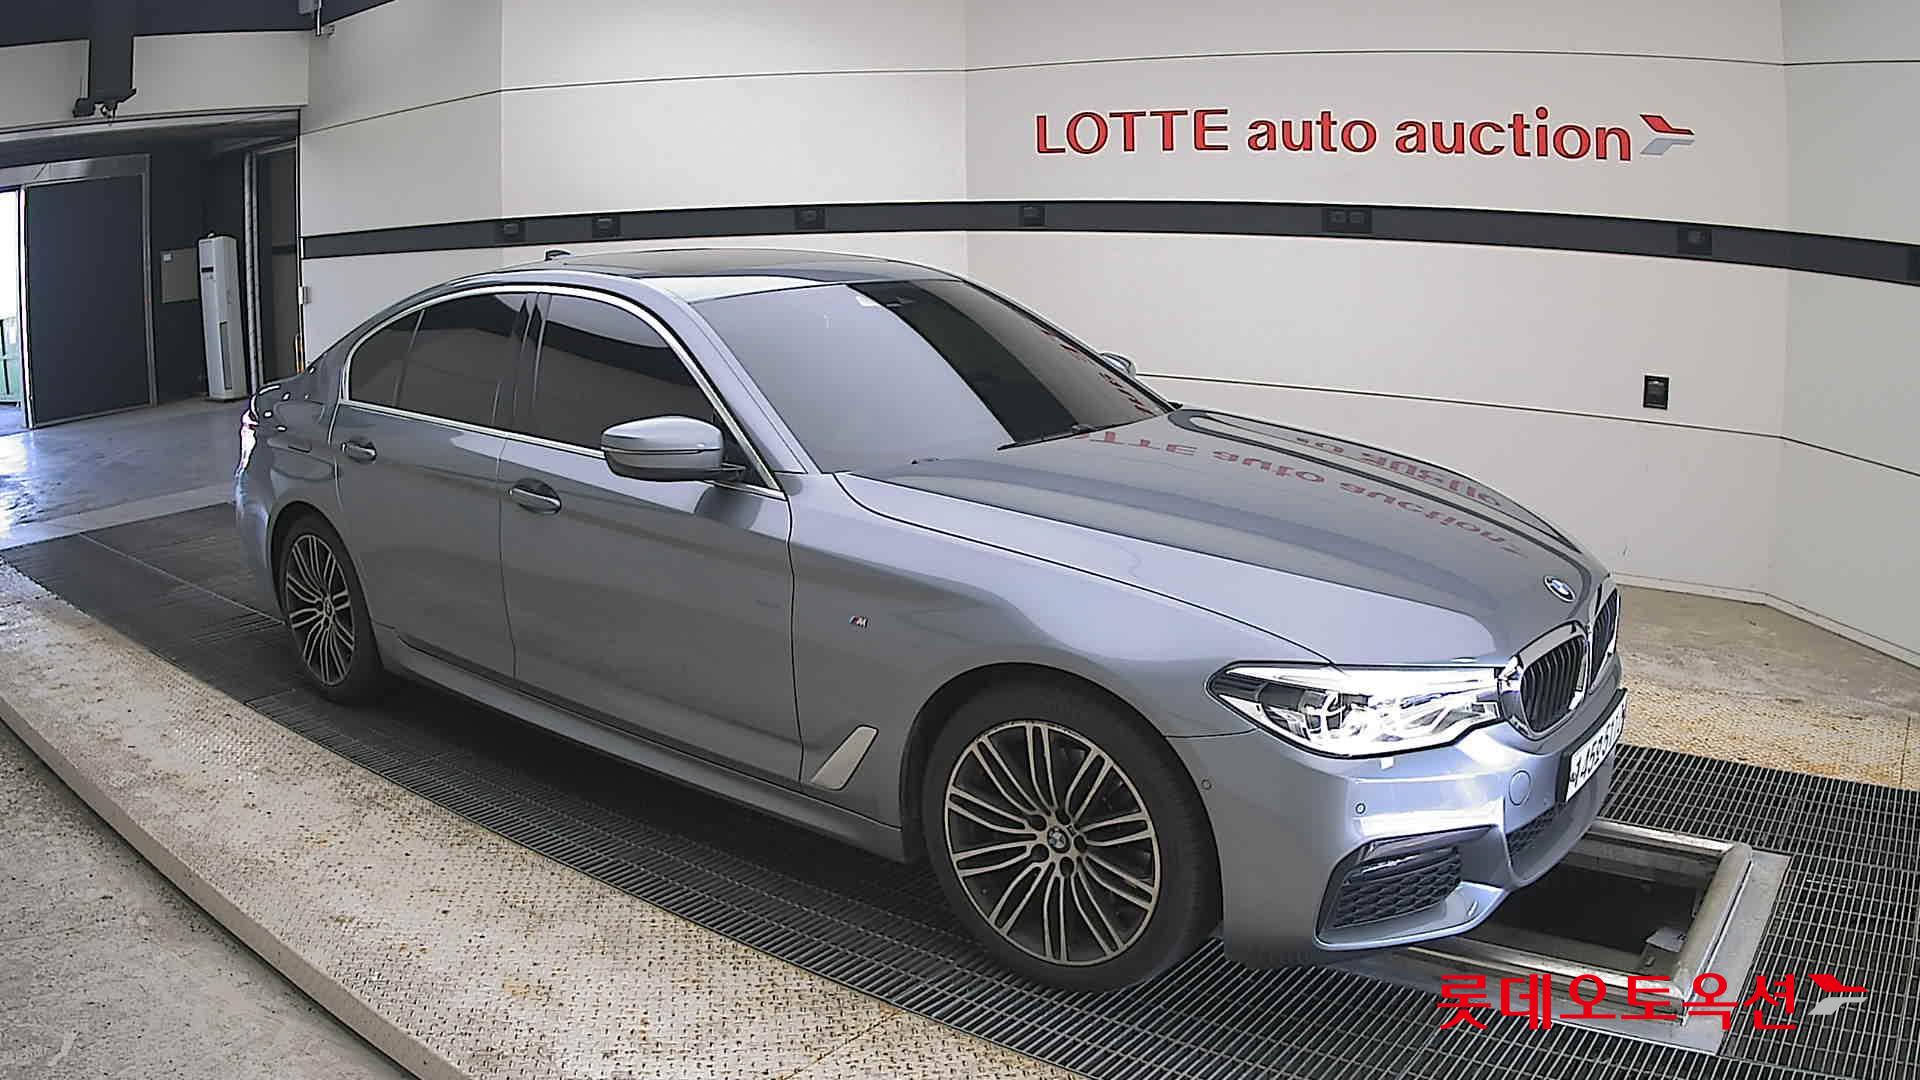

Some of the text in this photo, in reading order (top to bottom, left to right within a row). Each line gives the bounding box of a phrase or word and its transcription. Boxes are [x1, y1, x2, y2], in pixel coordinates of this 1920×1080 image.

[1035, 106, 1632, 162] LOTTE auto auction
